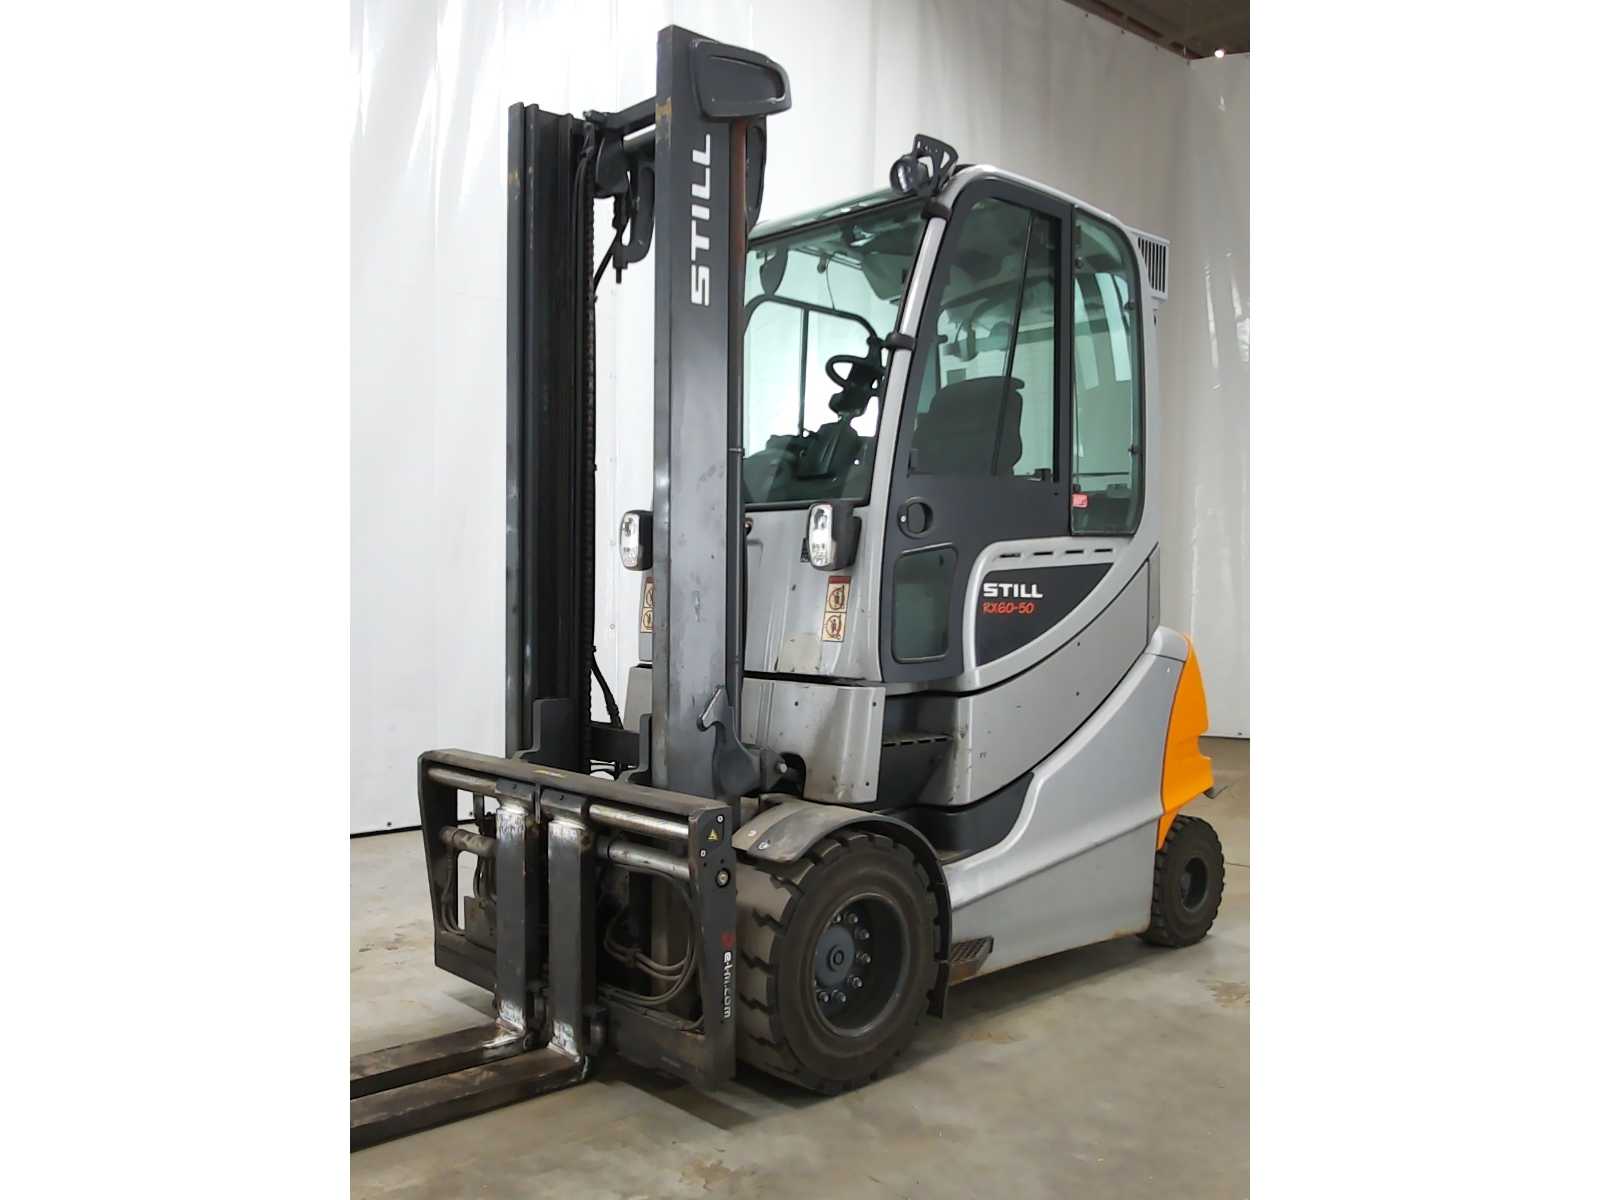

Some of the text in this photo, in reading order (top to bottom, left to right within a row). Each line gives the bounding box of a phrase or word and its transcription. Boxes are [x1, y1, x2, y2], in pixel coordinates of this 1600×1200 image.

[691, 133, 711, 307] STILL
[983, 582, 1044, 599] STILL
[983, 601, 1036, 615] RX60-50
